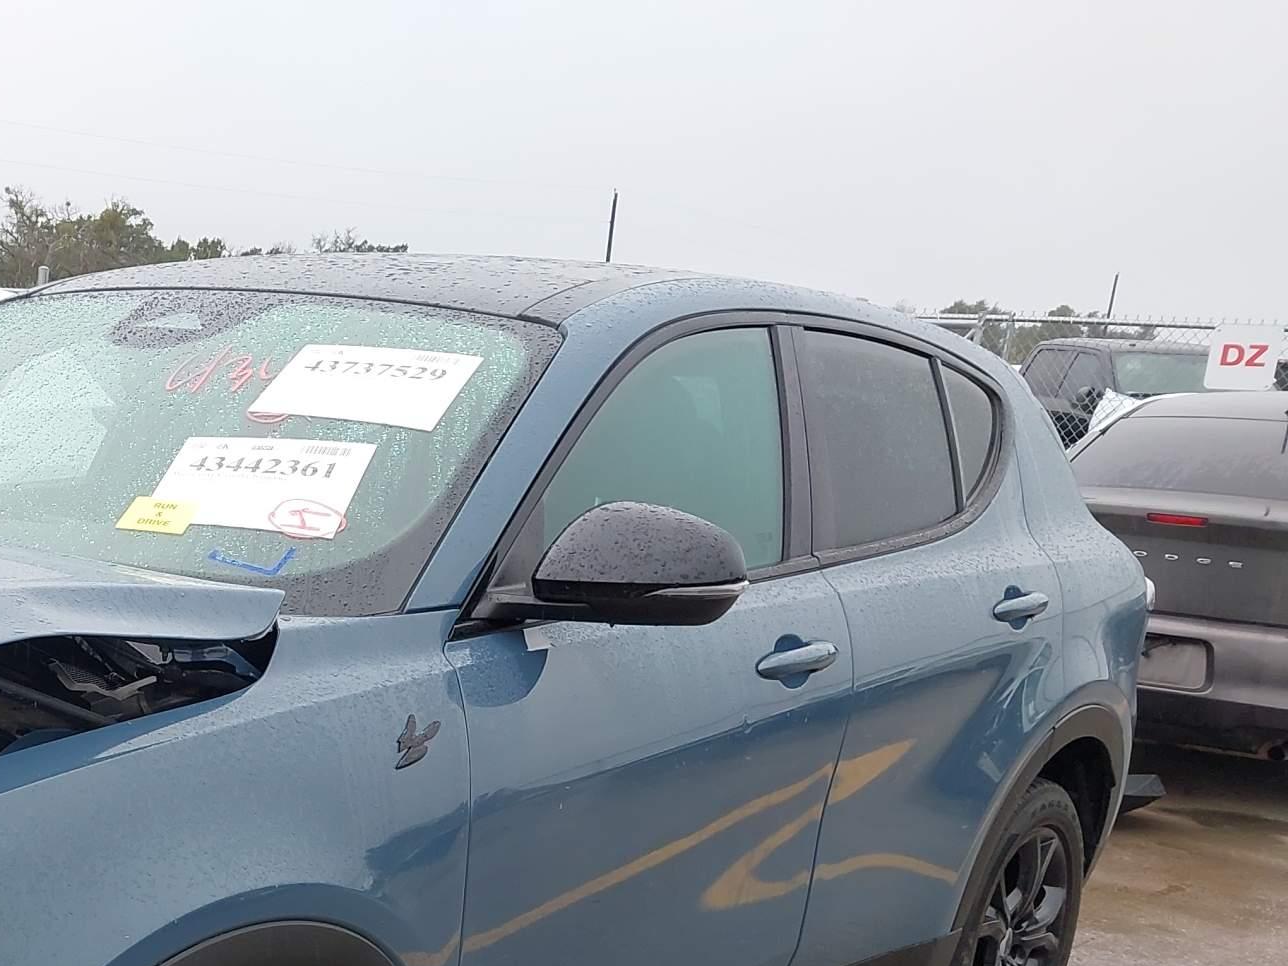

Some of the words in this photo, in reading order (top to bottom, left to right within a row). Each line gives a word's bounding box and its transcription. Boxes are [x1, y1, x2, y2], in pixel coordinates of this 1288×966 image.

[1219, 343, 1270, 367] DZ
[304, 359, 448, 381] 43737529
[189, 455, 338, 478] 43442361
[153, 502, 179, 510] RUN
[136, 517, 172, 527] DRIVE
[1133, 550, 1243, 569] ODGE
